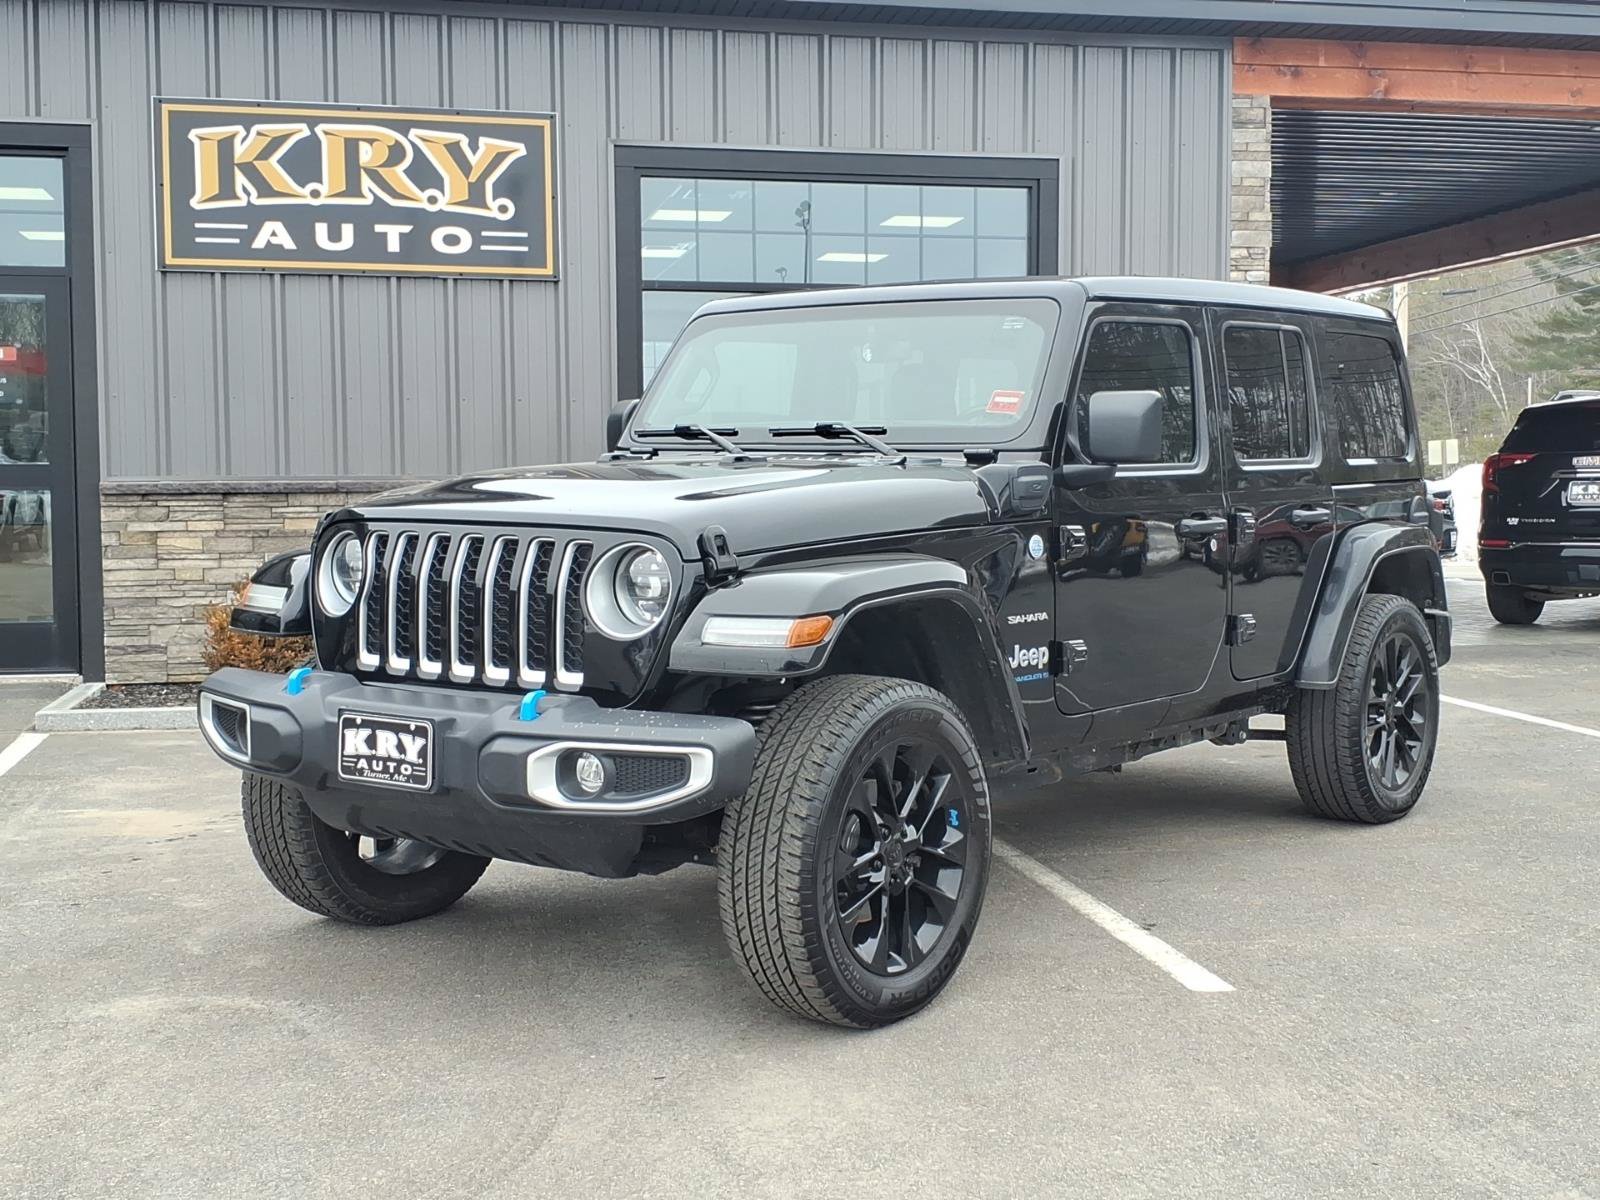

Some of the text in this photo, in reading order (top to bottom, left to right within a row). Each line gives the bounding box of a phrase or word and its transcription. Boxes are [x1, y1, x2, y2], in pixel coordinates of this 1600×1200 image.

[188, 123, 527, 221] K.R.Y.
[250, 221, 473, 254] AUTO
[1572, 456, 1600, 466] GM
[1007, 612, 1049, 625] SAHARA
[1008, 644, 1050, 669] Jeep
[357, 758, 412, 775] AUTO
[829, 938, 875, 1001] EVOLUTION
